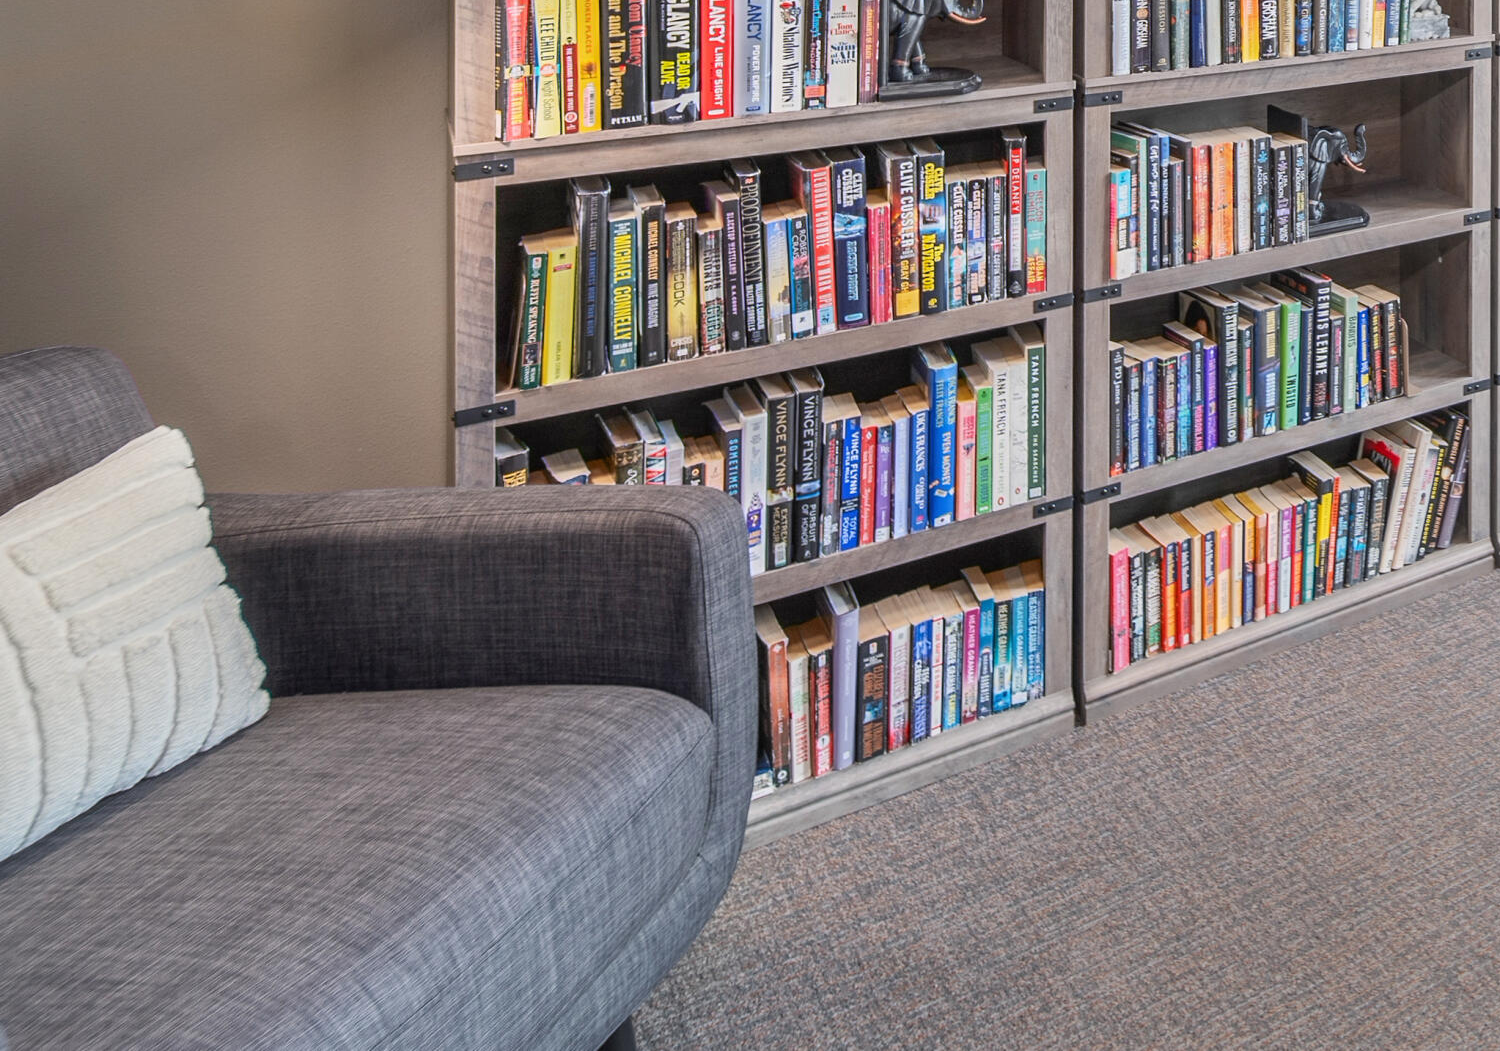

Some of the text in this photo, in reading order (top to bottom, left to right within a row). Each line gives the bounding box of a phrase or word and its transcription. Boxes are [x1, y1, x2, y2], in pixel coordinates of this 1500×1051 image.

[608, 15, 625, 37] and
[1136, 20, 1148, 49] GRISHAM
[1262, 0, 1277, 40] GRISHAM
[609, 40, 626, 64] The
[626, 24, 645, 68] Clancy
[714, 47, 723, 68] LINE
[783, 26, 802, 60] Shadow
[540, 17, 554, 121] LEE CHILD Night School
[606, 65, 626, 110] Dragon
[660, 60, 675, 85] ALIVE
[676, 52, 690, 90] DEAD OR
[716, 69, 723, 78] OF
[782, 62, 799, 103] Warriors
[714, 79, 723, 106] SIGHT
[842, 168, 854, 207] CUSSLER
[853, 173, 863, 200] CLIVE
[925, 163, 935, 200] CUSSLER
[934, 167, 944, 193] CLIVE
[1011, 154, 1021, 212] JP DELANEY
[900, 161, 914, 247] CLIVE CUSSLER
[953, 185, 963, 244] CLIVE CUSSLER
[740, 183, 762, 284] PROOF OF INTENT
[934, 243, 944, 262] The
[922, 234, 935, 292] NAVIGATOR
[614, 234, 632, 340] MICHAEL CONNELLY
[1316, 287, 1330, 375] DENNIS LEHANE
[997, 372, 1006, 436] TANA FRENCH
[1114, 366, 1122, 405] PD James
[1286, 374, 1297, 408] TWISTED
[776, 401, 787, 487] VINCE FLYNN
[802, 396, 815, 481] VINCE FLYNN
[915, 413, 926, 472] DICK FRANCIS
[1449, 418, 1464, 465] WALTER MOSLEY
[728, 439, 739, 496] SOMETIMES
[849, 431, 860, 494] VINCE FLYNN
[801, 504, 809, 546] OF HONOR
[809, 504, 817, 543] PURSUIT
[849, 516, 857, 540] TOTAL
[1432, 517, 1441, 538] BROWN
[998, 604, 1008, 663] HEATHER GRAHAM
